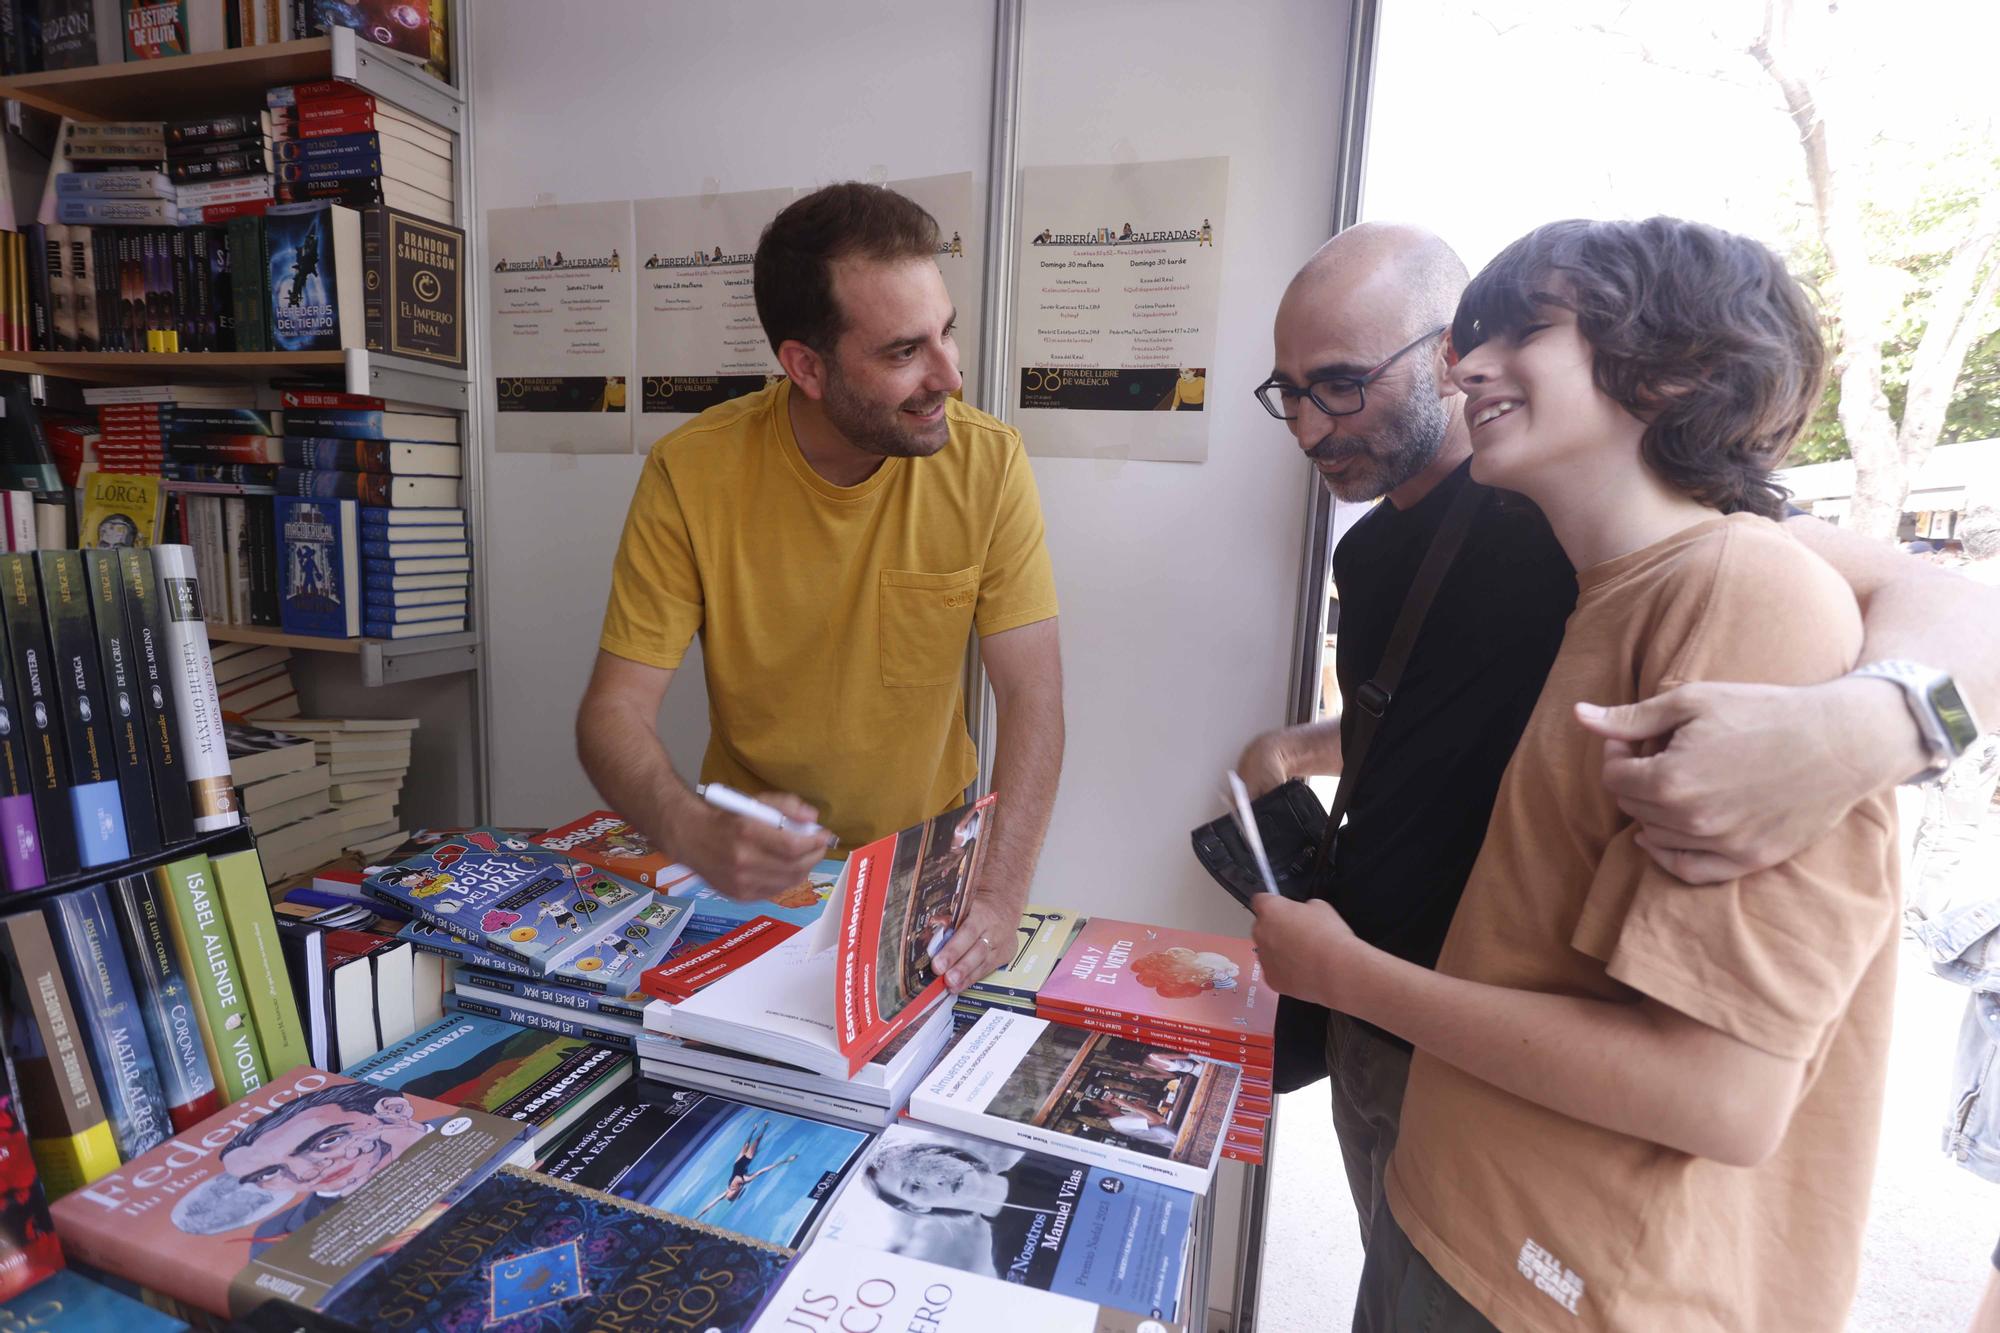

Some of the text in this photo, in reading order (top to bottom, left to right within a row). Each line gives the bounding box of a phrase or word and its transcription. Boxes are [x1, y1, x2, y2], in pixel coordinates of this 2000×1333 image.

[127, 6, 178, 30] LA ESTIRPE
[134, 25, 175, 46] DE LILITH
[404, 231, 449, 254] BRANDON
[1049, 229, 1197, 245] LIBRERÍA GALERADAS
[398, 244, 455, 271] SANDERSON
[505, 257, 609, 271] LIBRERÍA GALERADAS
[656, 254, 696, 267] LIBRERÍA
[1040, 261, 1066, 269] Domingo
[1077, 260, 1104, 268] mañana
[1130, 259, 1156, 268] Domingo
[1167, 257, 1187, 265] tarde
[276, 304, 332, 317] HEREDEROS
[278, 317, 332, 330] DEL TIEMPO
[401, 301, 453, 325] EL IMPERIO
[413, 319, 442, 337] FINAL
[1026, 368, 1061, 391] 58
[1063, 378, 1073, 386] DE
[96, 484, 147, 504] LORCA
[12, 557, 28, 606] ALFAGUARA
[56, 556, 72, 603] ALFAGUARA
[98, 558, 114, 602] ALFAGUARA
[128, 554, 145, 599] ALFAGUARA
[111, 638, 123, 662] CRUZ
[143, 628, 157, 663] MOLINO
[26, 648, 43, 697] MONTERO
[114, 662, 124, 673] LA
[116, 674, 126, 687] DE
[148, 664, 159, 680] DEL
[201, 655, 215, 702] PEQUEÑO
[182, 640, 214, 755] MÁXIMO HUERTA
[73, 655, 102, 781] del acordeonista ATXAGA
[164, 754, 174, 765] Un
[540, 817, 625, 851] Bestiari
[442, 858, 510, 895] BOLES
[450, 861, 480, 876] LES
[462, 862, 538, 904] DEL DRAC
[143, 900, 171, 976] JOSÉ LUIS CORRAL
[186, 872, 206, 930] ISABEL
[203, 933, 237, 1008] ALLENDE
[421, 910, 479, 942] LES BOLES DEL DRAC
[84, 917, 114, 998] JOSÉ LUIS CORRAL
[472, 954, 530, 975] BOLES DEL DRAC
[659, 948, 721, 977] Esmorzars
[719, 920, 774, 951] valencians
[845, 856, 869, 1045] Esmorzars valencians
[1072, 945, 1105, 980] JULIA Y
[1094, 939, 1135, 985] EL VIENTO
[522, 985, 589, 1009] LES BOLES DEL DRAC
[865, 990, 873, 1028] VICENT
[171, 1004, 194, 1069] CORONA
[408, 1014, 465, 1049] Lorenzo
[509, 1010, 573, 1034] LES BOLES DEL DRAC
[37, 972, 91, 1109] EL HOMBRE DE NEANDERTAL
[364, 1024, 476, 1083] Tostonazo
[930, 1055, 971, 1095] Almuerzos
[968, 1015, 1004, 1054] valencianos
[111, 1027, 158, 1141] MATAR AL REY
[527, 1047, 614, 1116] asquerosos
[80, 1073, 328, 1212] Federico
[567, 1104, 626, 1158] Araújo Gámir
[582, 1102, 651, 1167] A ESA CHICA
[1017, 1132, 1048, 1145] Vicent Marco
[1040, 1168, 1083, 1252] Manuel Vilas
[1010, 1213, 1047, 1274] Nosotros
[1075, 1256, 1094, 1287] Premio
[1085, 1222, 1104, 1253] Nadal
[379, 1198, 537, 1333] STADLER
